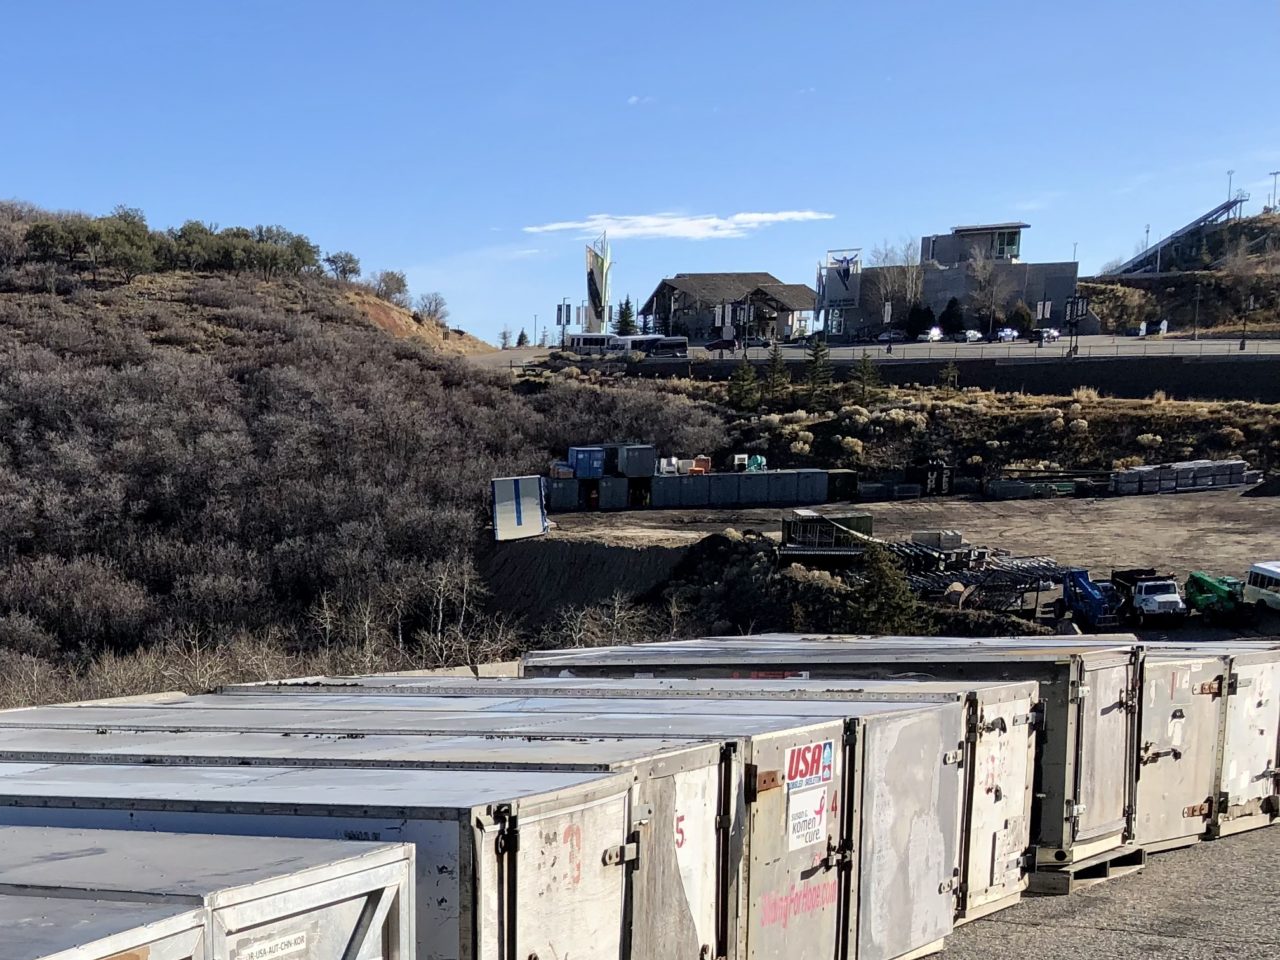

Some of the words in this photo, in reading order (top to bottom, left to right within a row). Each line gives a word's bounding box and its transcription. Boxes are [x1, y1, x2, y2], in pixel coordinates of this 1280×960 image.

[787, 743, 822, 781] USA
[831, 789, 838, 819] 4
[675, 815, 686, 848] 5
